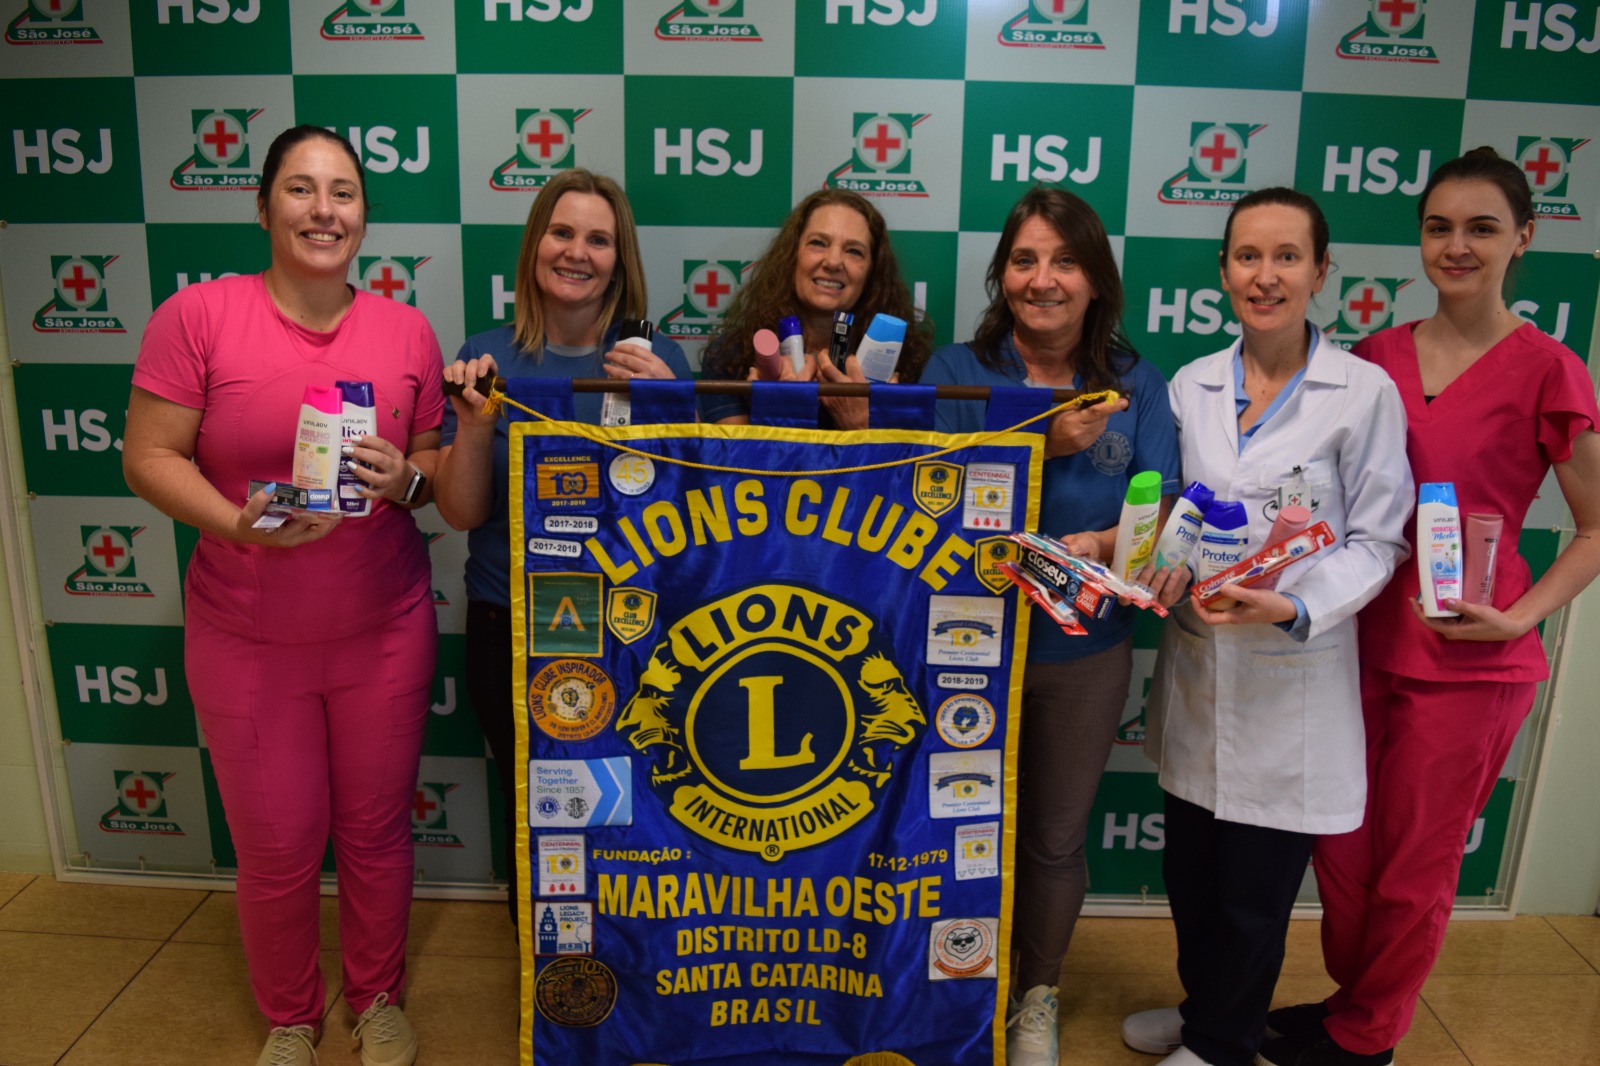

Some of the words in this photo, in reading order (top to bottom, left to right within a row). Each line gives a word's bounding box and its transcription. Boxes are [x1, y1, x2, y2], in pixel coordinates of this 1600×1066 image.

[17, 28, 48, 40] São
[53, 28, 91, 40] José
[334, 23, 366, 35] São
[372, 23, 412, 35] José
[669, 24, 702, 35] São
[708, 24, 751, 36] José
[1012, 31, 1047, 42] São
[1051, 31, 1095, 43] José
[1350, 43, 1383, 55] São
[1388, 44, 1429, 57] José
[13, 128, 113, 174] HSJ
[654, 128, 763, 176] HSJ
[990, 134, 1101, 184] HSJ
[1322, 145, 1431, 196] HSJ
[183, 175, 213, 186] São
[219, 174, 258, 185] José
[503, 175, 536, 186] São
[837, 180, 870, 191] São
[875, 180, 918, 191] José
[1172, 189, 1205, 200] São
[45, 318, 73, 328] São
[78, 317, 115, 328] José
[669, 324, 702, 335] São
[616, 461, 649, 484] 45
[549, 520, 594, 529] 2017-2018
[584, 479, 768, 586] LIONS
[785, 479, 976, 592] CLUBE
[533, 542, 577, 553] 2017-2018
[1202, 548, 1242, 562] Protex
[1027, 551, 1069, 588] closeup
[76, 582, 103, 591] São
[109, 583, 144, 592] José
[613, 617, 645, 627] EXCELLENCE
[679, 593, 862, 662] LIONS
[534, 667, 558, 691] CLUBE
[556, 662, 607, 686] INSPIRADOR
[942, 676, 984, 685] 2018-2019
[74, 665, 168, 706] HSJ
[531, 694, 547, 721] LIONS
[739, 675, 815, 770] L
[537, 767, 572, 776] Serving
[537, 776, 578, 786] Together
[537, 786, 562, 794] Since
[565, 786, 585, 794] 1957
[684, 793, 860, 842] INTERNATIONAL
[110, 820, 136, 829] São
[142, 822, 175, 831] José
[593, 848, 681, 865] FUNDAÇÃO
[868, 849, 948, 871] 17-12-1979
[597, 872, 819, 919] MARAVILHA
[825, 875, 942, 925] OESTE
[677, 926, 800, 956] DISTRITO
[807, 928, 867, 959] LD-8
[656, 962, 741, 996] SANTA
[750, 963, 883, 997] CATARINA
[710, 998, 821, 1026] BRASIL
